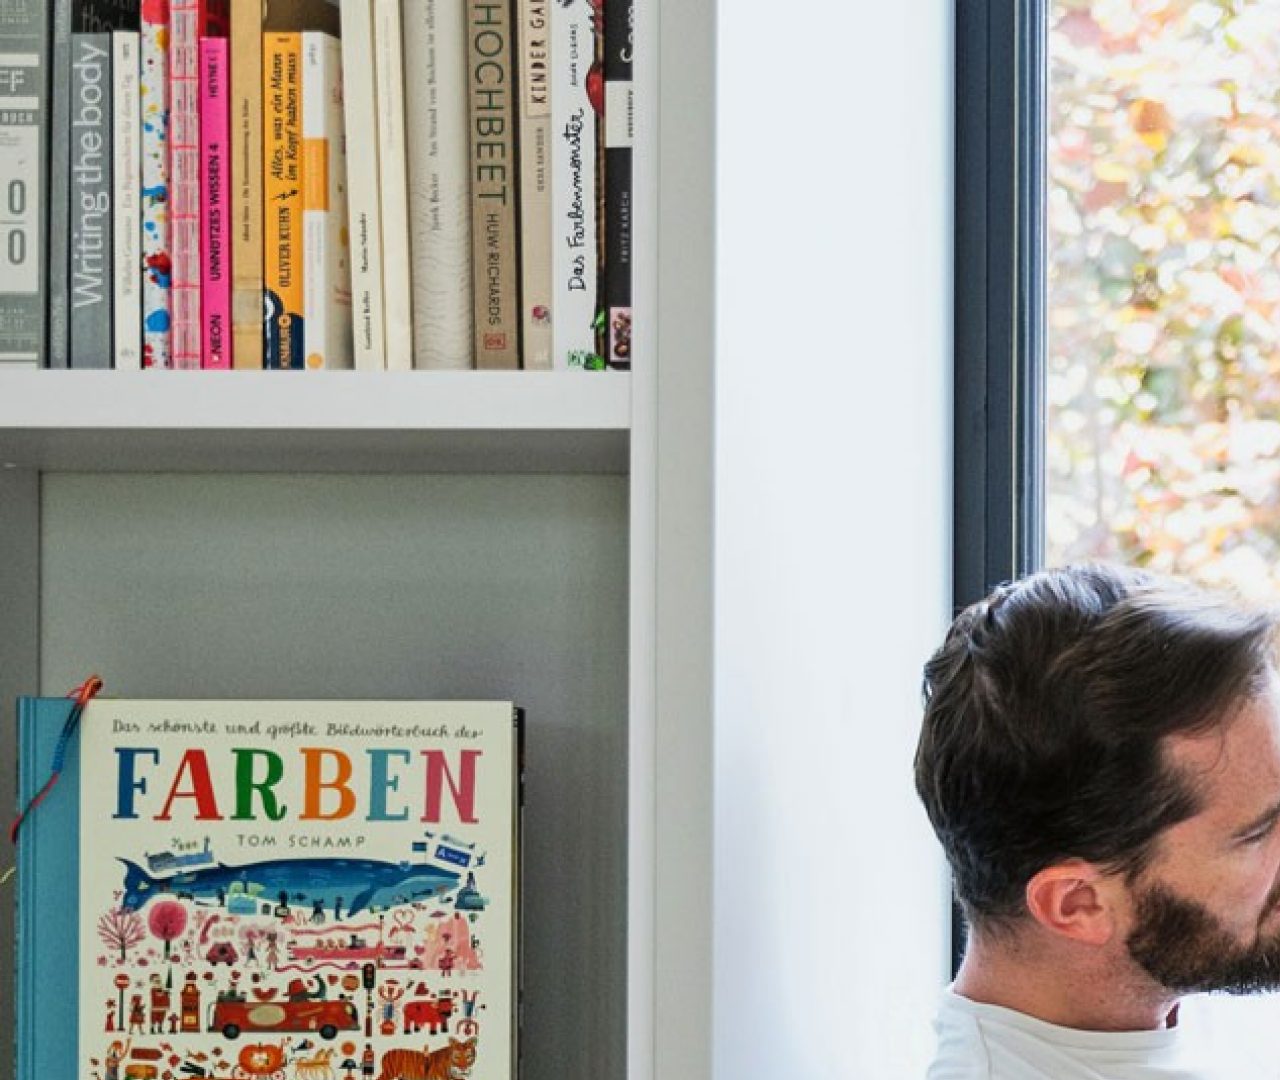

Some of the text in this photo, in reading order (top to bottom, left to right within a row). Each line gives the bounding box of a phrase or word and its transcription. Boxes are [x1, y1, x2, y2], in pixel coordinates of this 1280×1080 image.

[208, 63, 218, 98] HEYNE
[474, 4, 505, 206] HOCHBEET
[530, 40, 547, 104] KINDER
[209, 143, 219, 152] 4
[271, 52, 284, 180] Alles, was ein Mann
[284, 52, 301, 180] im Kopf haben muss
[72, 42, 108, 307] Writing the body
[209, 155, 220, 205] WISSEN
[563, 107, 586, 291] Das Farbenmonster
[278, 207, 290, 287] OLIVER KUHN
[486, 213, 499, 249] HUW
[486, 252, 502, 326] RICHARDS
[210, 315, 221, 354] NEON
[112, 719, 141, 735] Das
[148, 719, 218, 736] schönste
[226, 719, 260, 736] und
[267, 720, 318, 740] größte
[454, 727, 484, 740] der
[111, 747, 484, 824] FARBEN
[236, 834, 367, 849] TOM SCHAMP
